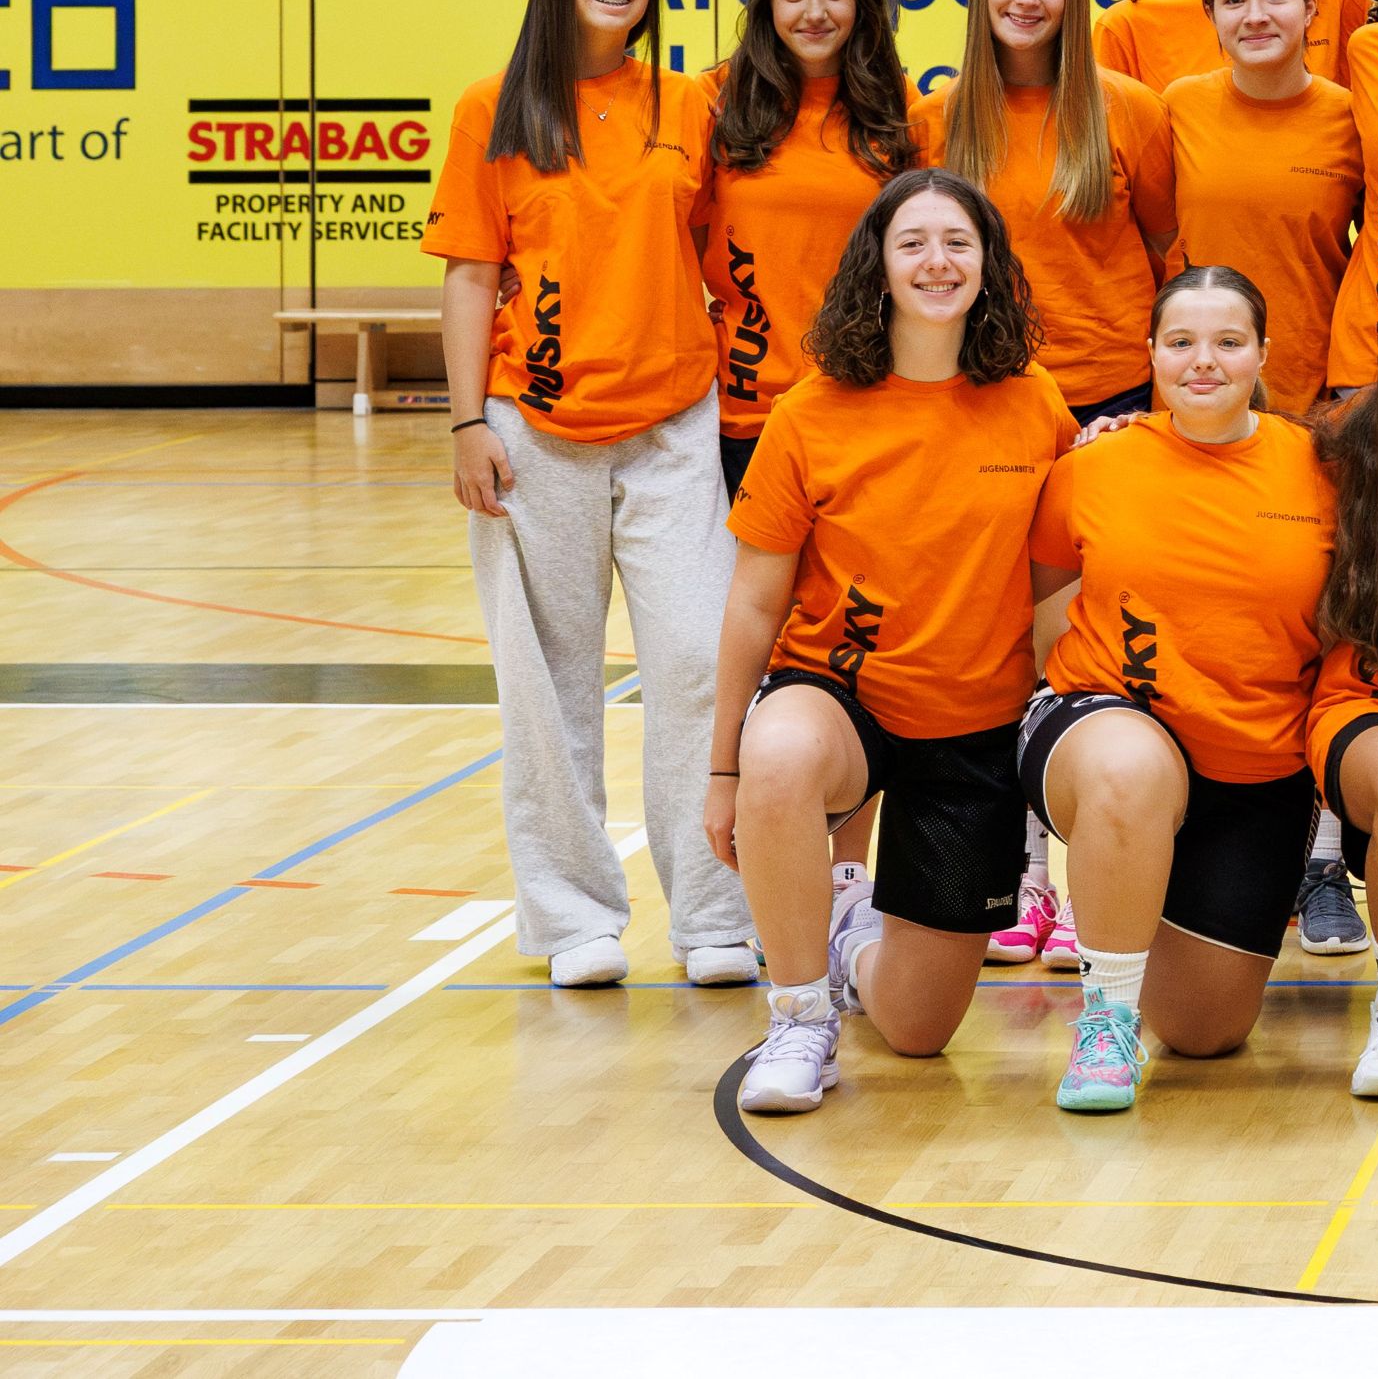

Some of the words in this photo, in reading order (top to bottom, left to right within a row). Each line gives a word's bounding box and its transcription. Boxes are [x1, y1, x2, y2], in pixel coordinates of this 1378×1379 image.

[80, 117, 131, 161] of
[187, 120, 431, 162] STRABAG
[215, 194, 343, 215] PROPERTY
[350, 194, 406, 215] AND
[197, 221, 304, 243] FACILITY
[310, 221, 424, 243] SERVICES
[726, 235, 770, 403] HUSKY
